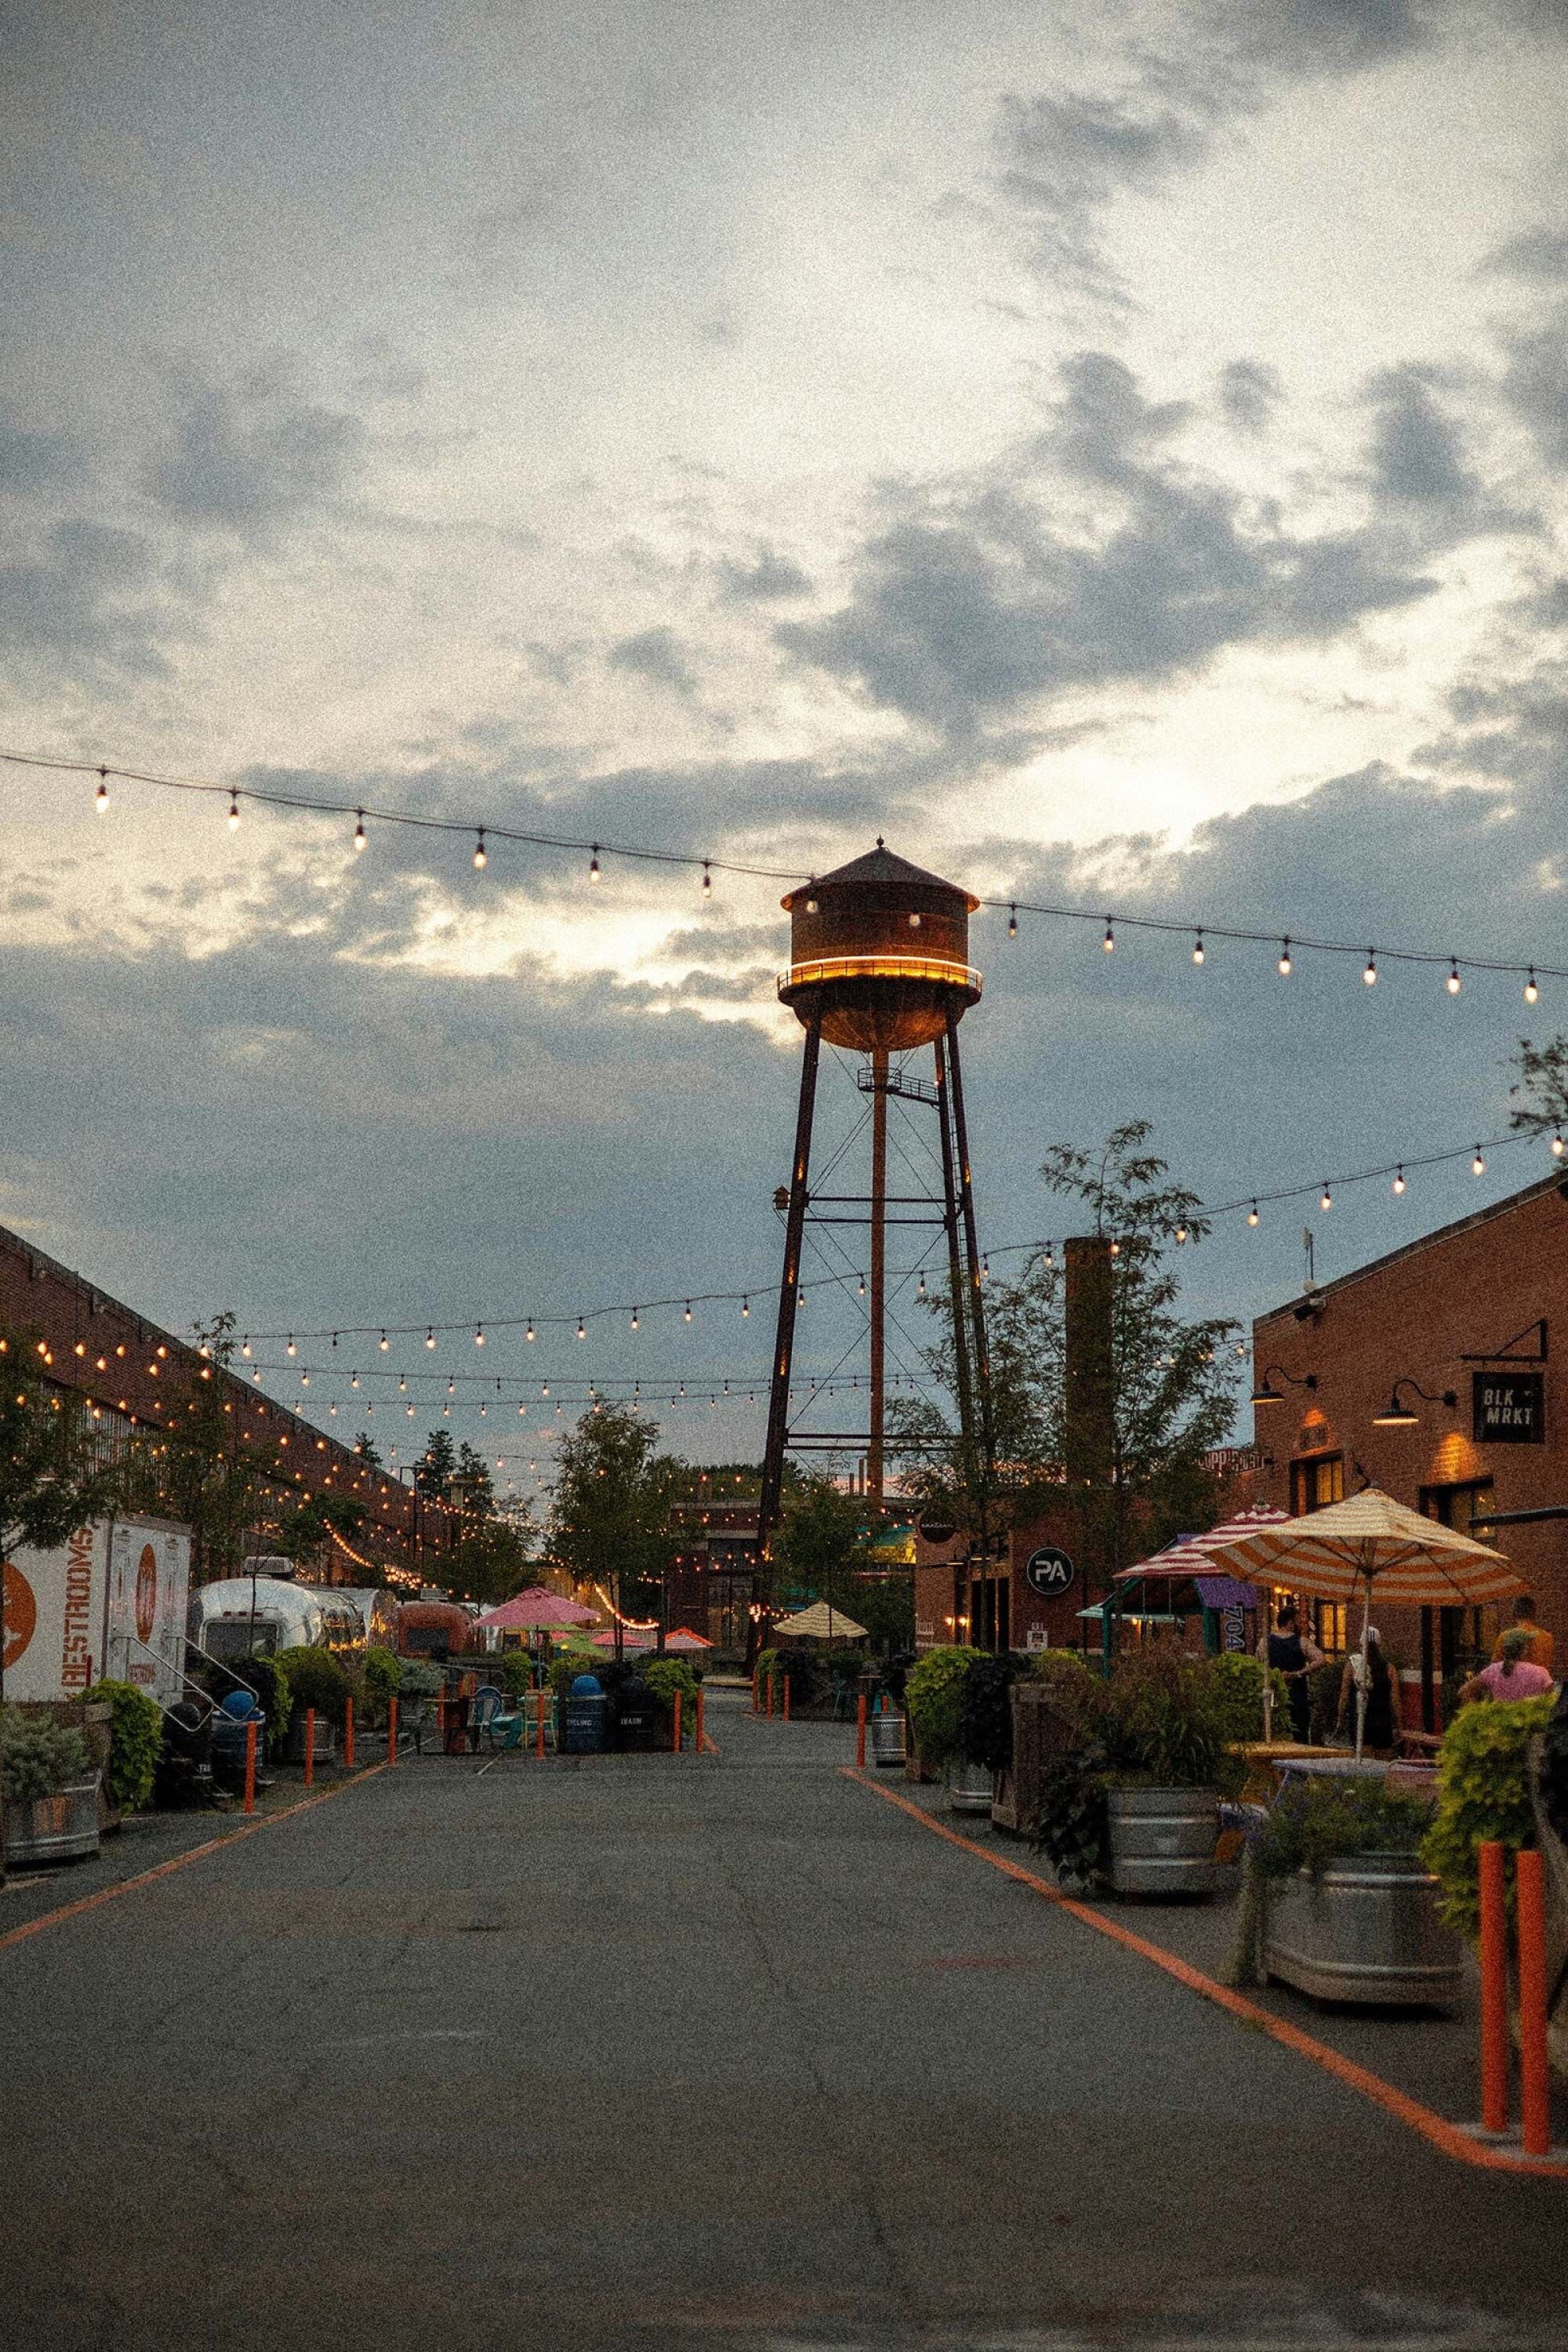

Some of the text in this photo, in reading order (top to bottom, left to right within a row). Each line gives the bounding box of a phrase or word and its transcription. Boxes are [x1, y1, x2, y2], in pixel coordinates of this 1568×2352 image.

[1483, 1388, 1514, 1406] BLK
[1486, 1407, 1533, 1425] MRKT
[1034, 1559, 1068, 1582] PA
[61, 1527, 93, 1687] RESTROOMS
[1223, 1605, 1246, 1651] 704
